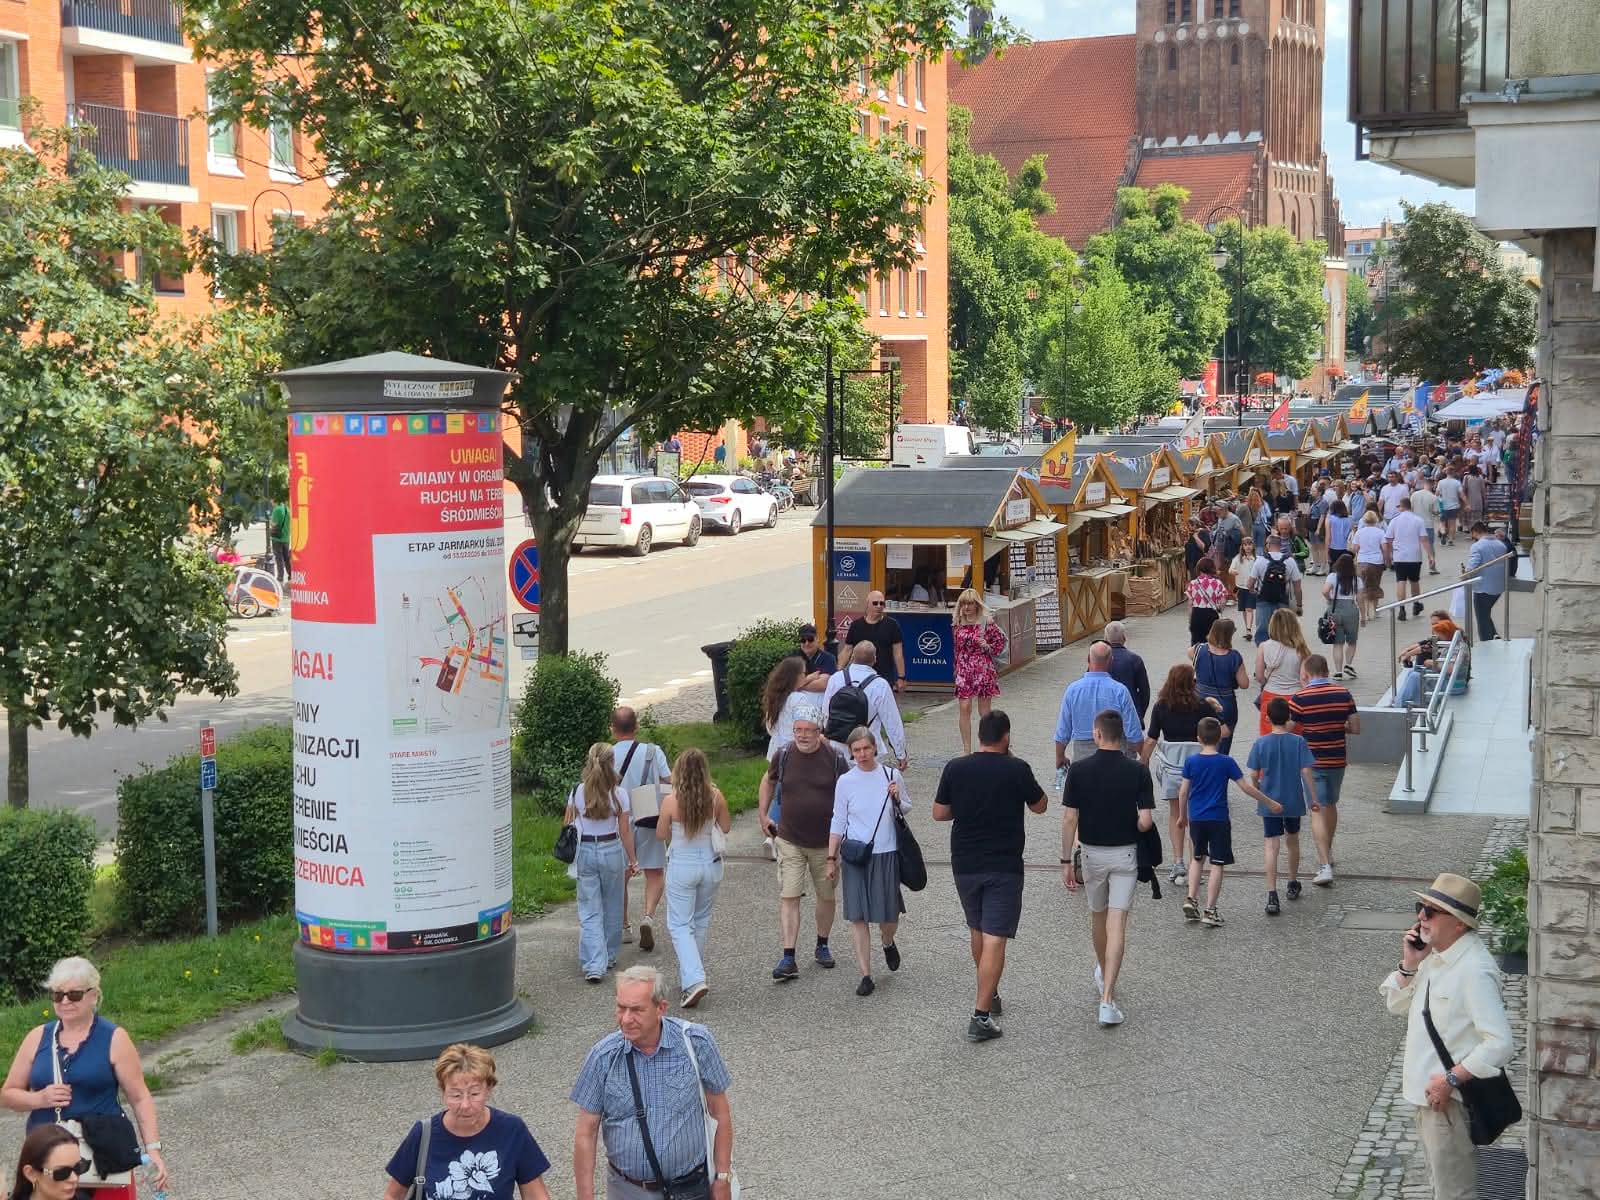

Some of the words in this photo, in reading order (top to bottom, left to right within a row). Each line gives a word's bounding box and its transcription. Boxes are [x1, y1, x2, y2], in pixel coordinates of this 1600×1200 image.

[450, 447, 497, 465] UWAGA!
[399, 471, 456, 486] ZMIANY
[459, 470, 471, 484] W
[420, 489, 467, 505] RUCHU
[470, 488, 484, 502] NA
[408, 542, 436, 553] ETAP
[438, 538, 485, 551] JARMARKU
[292, 648, 334, 681] AGA!
[912, 657, 948, 665] LUBIANA
